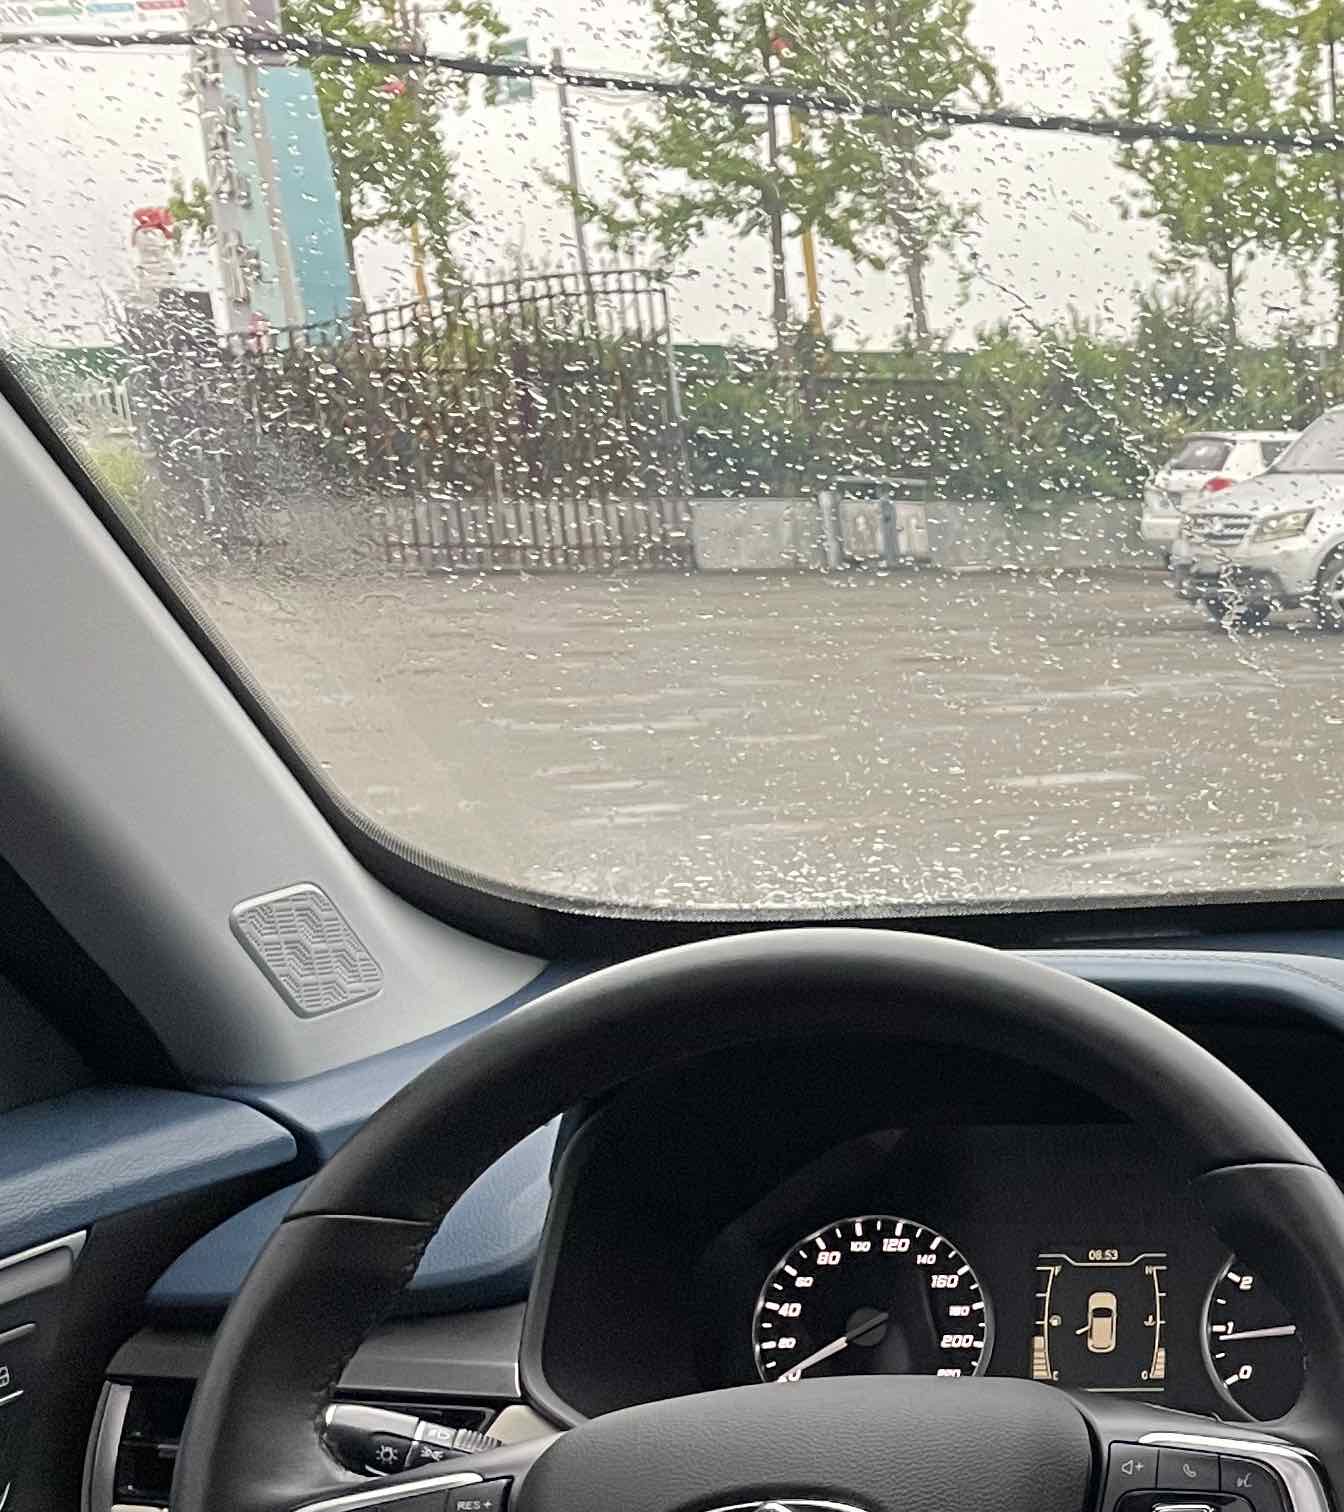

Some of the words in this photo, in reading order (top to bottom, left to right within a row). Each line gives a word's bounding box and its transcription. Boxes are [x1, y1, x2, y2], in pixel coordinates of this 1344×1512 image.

[850, 1241, 871, 1252] 100
[882, 1238, 910, 1252] 120
[816, 1251, 841, 1265] 80
[916, 1254, 936, 1264] 140
[1088, 1249, 1119, 1260] 08:53
[795, 1276, 814, 1287] 60
[930, 1275, 959, 1288] 160
[1239, 1276, 1253, 1290] 2
[778, 1303, 801, 1317] 40
[949, 1305, 970, 1316] 180
[1226, 1321, 1234, 1334] 1
[778, 1337, 796, 1348] 20
[940, 1335, 974, 1348] 200
[1239, 1364, 1252, 1379] 0
